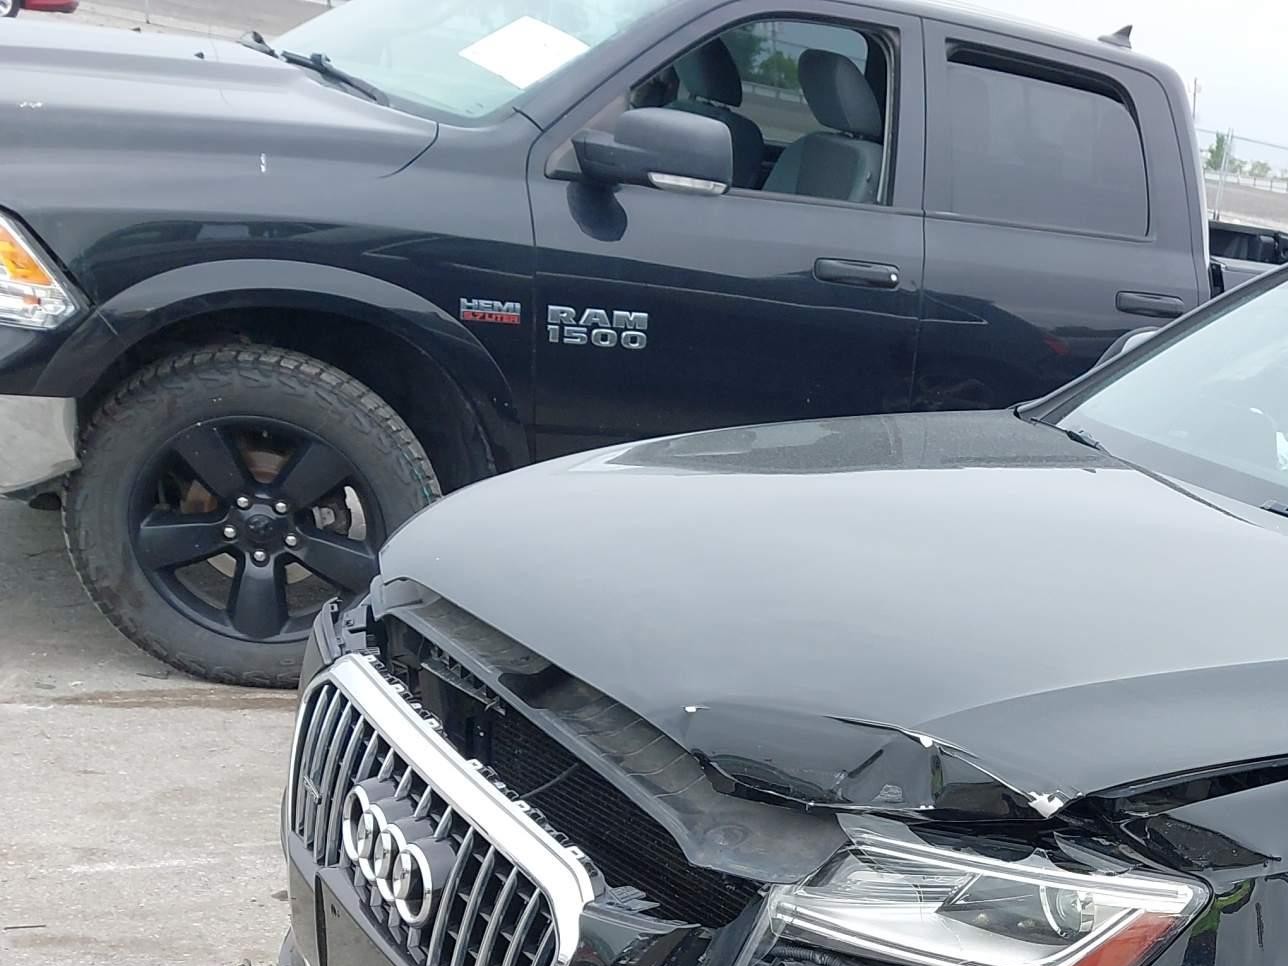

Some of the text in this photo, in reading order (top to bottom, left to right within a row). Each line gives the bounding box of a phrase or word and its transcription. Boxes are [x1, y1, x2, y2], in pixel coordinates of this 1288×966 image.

[460, 297, 521, 314] HEMI
[547, 304, 649, 330] RAM
[547, 324, 648, 350] 1500
